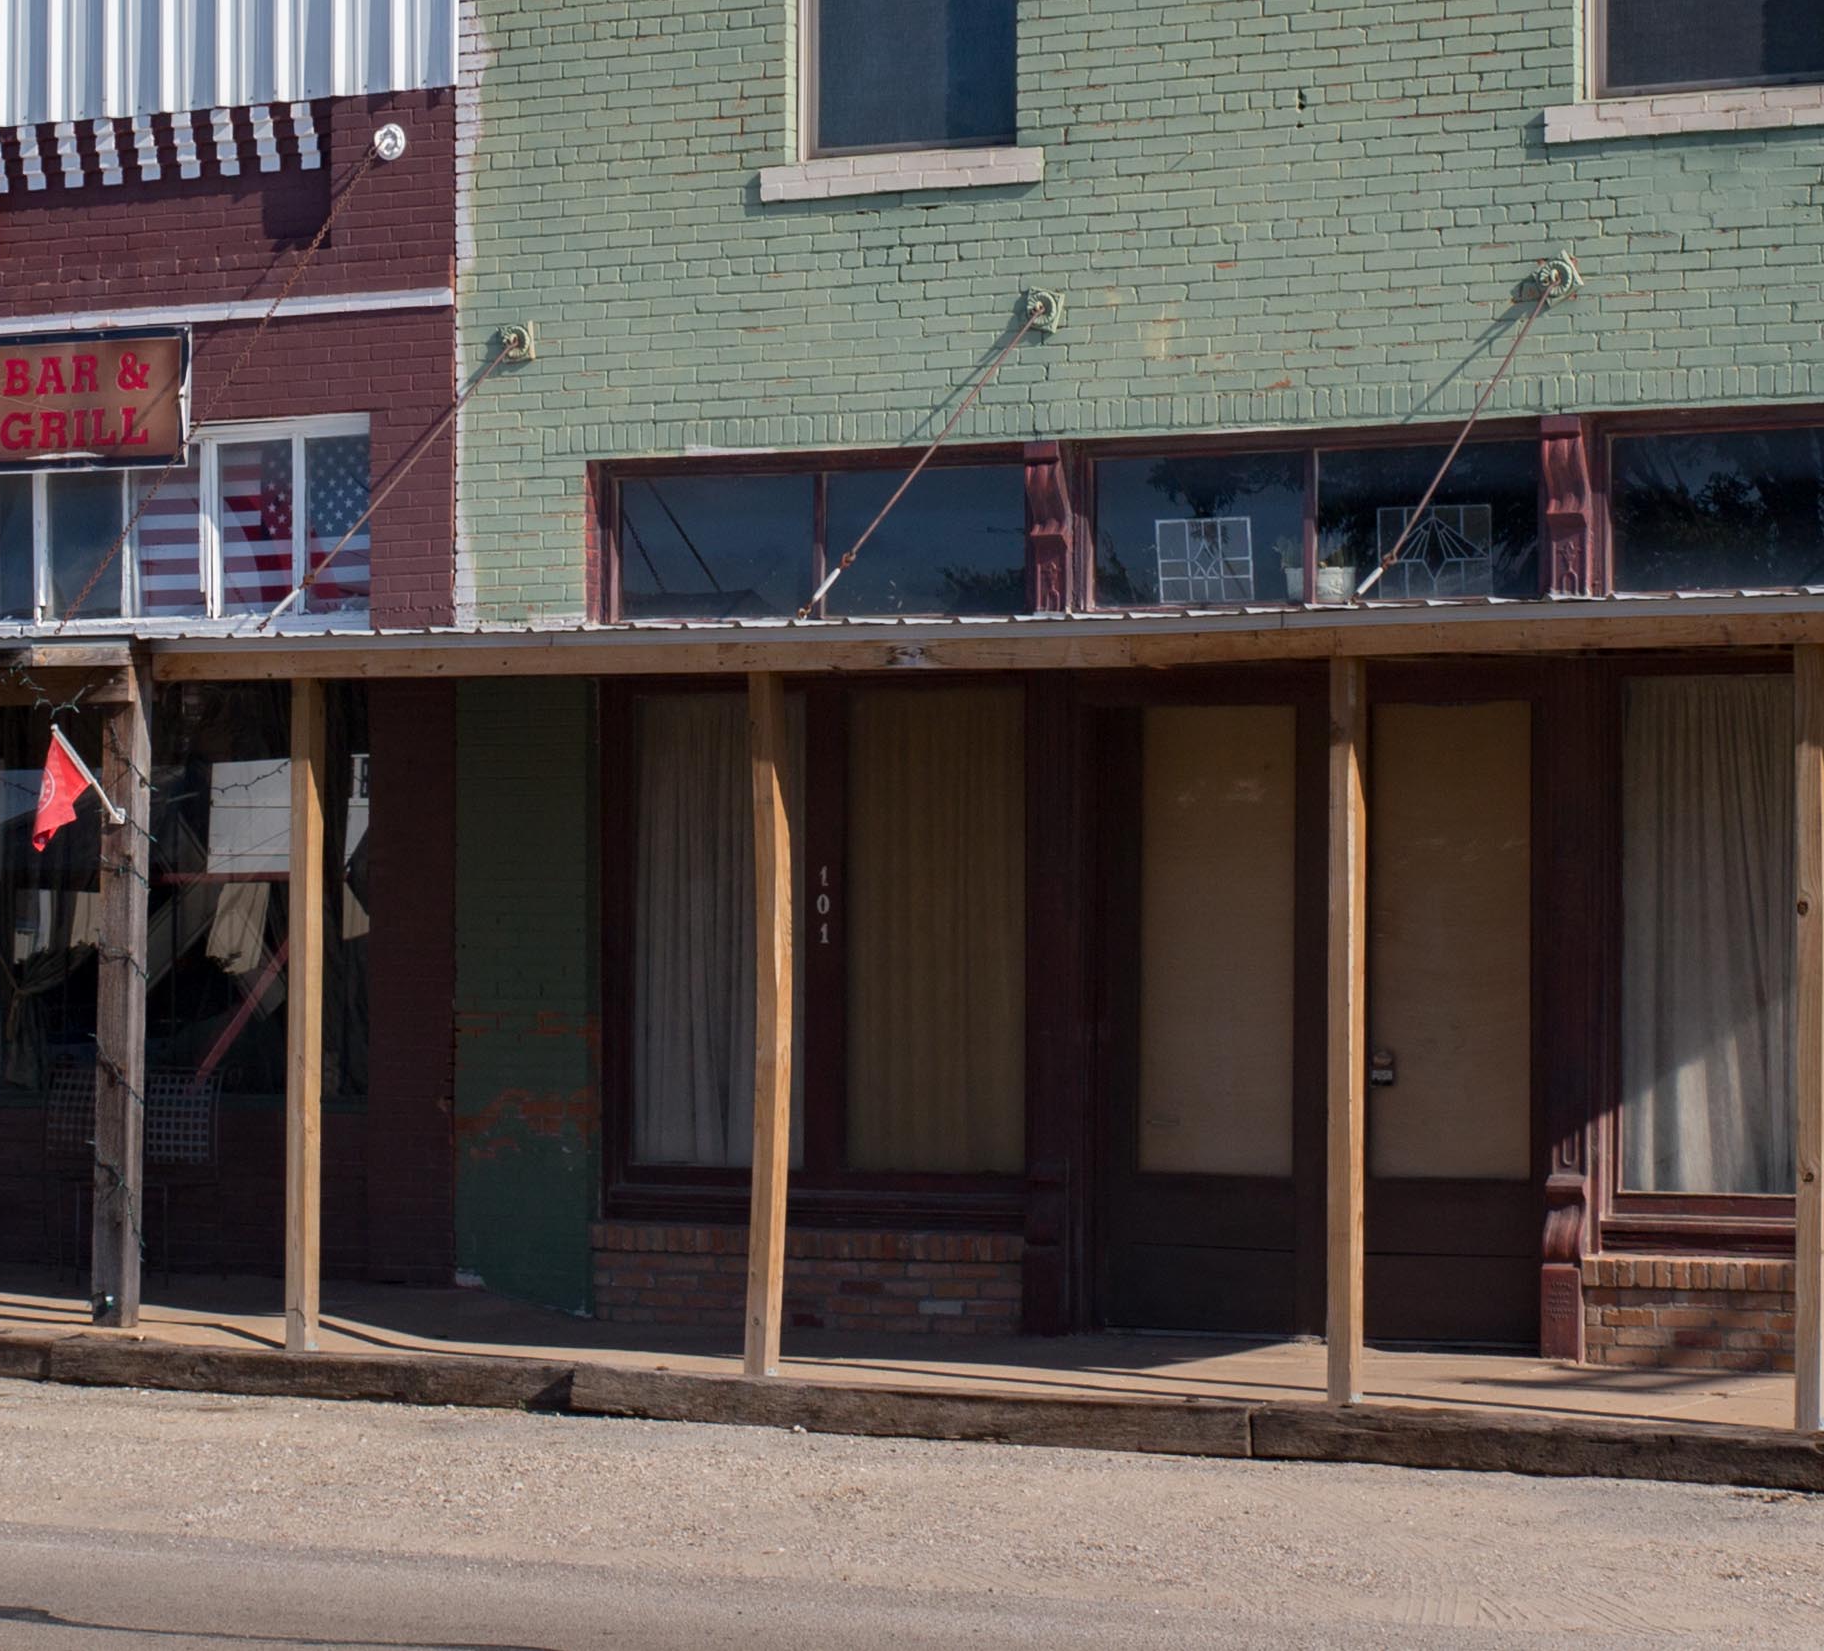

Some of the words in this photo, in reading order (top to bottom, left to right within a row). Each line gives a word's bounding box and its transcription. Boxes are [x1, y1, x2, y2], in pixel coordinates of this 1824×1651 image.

[4, 354, 99, 396] BAR
[117, 351, 150, 391] &
[0, 406, 150, 451] GRILL
[816, 865, 831, 944] 101
